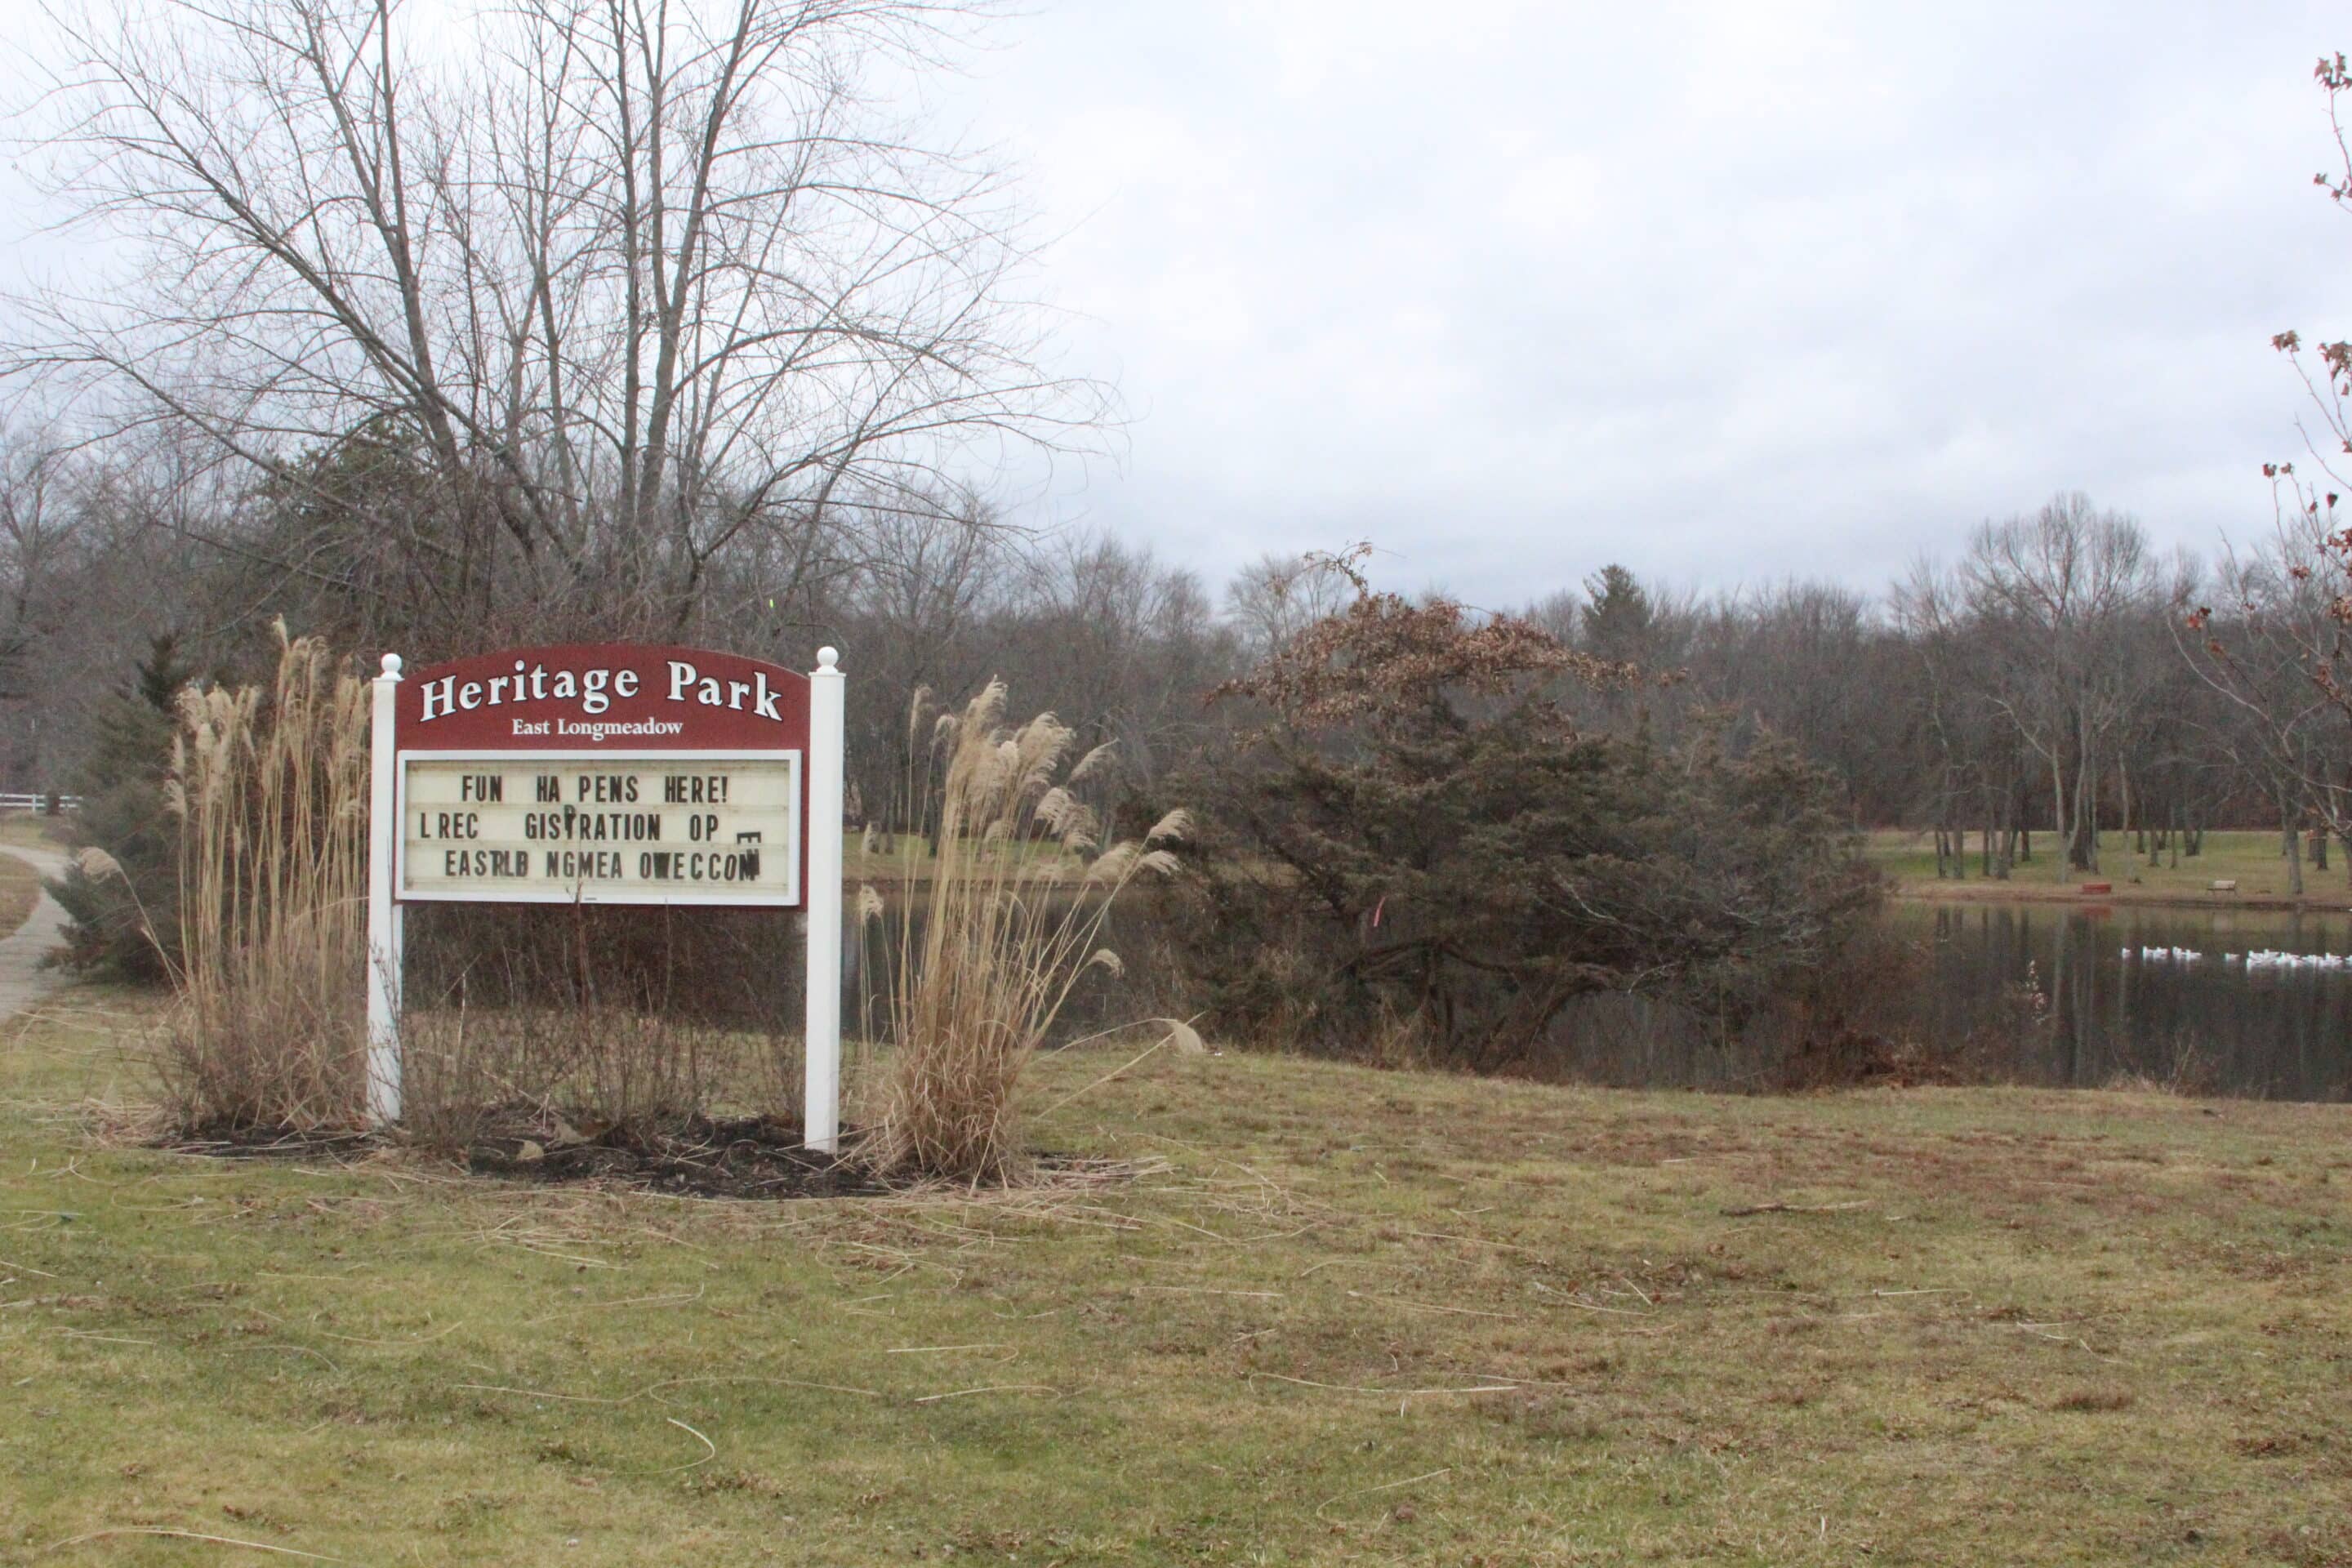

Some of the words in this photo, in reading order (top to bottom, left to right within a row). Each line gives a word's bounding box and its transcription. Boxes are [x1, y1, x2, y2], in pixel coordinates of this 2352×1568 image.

[420, 659, 639, 722] Heritage
[667, 661, 782, 721] Park
[512, 718, 550, 734] East
[558, 717, 684, 741] Longmeadow
[461, 775, 502, 802] FUN
[665, 776, 728, 803] HERE!
[439, 813, 479, 839] REC
